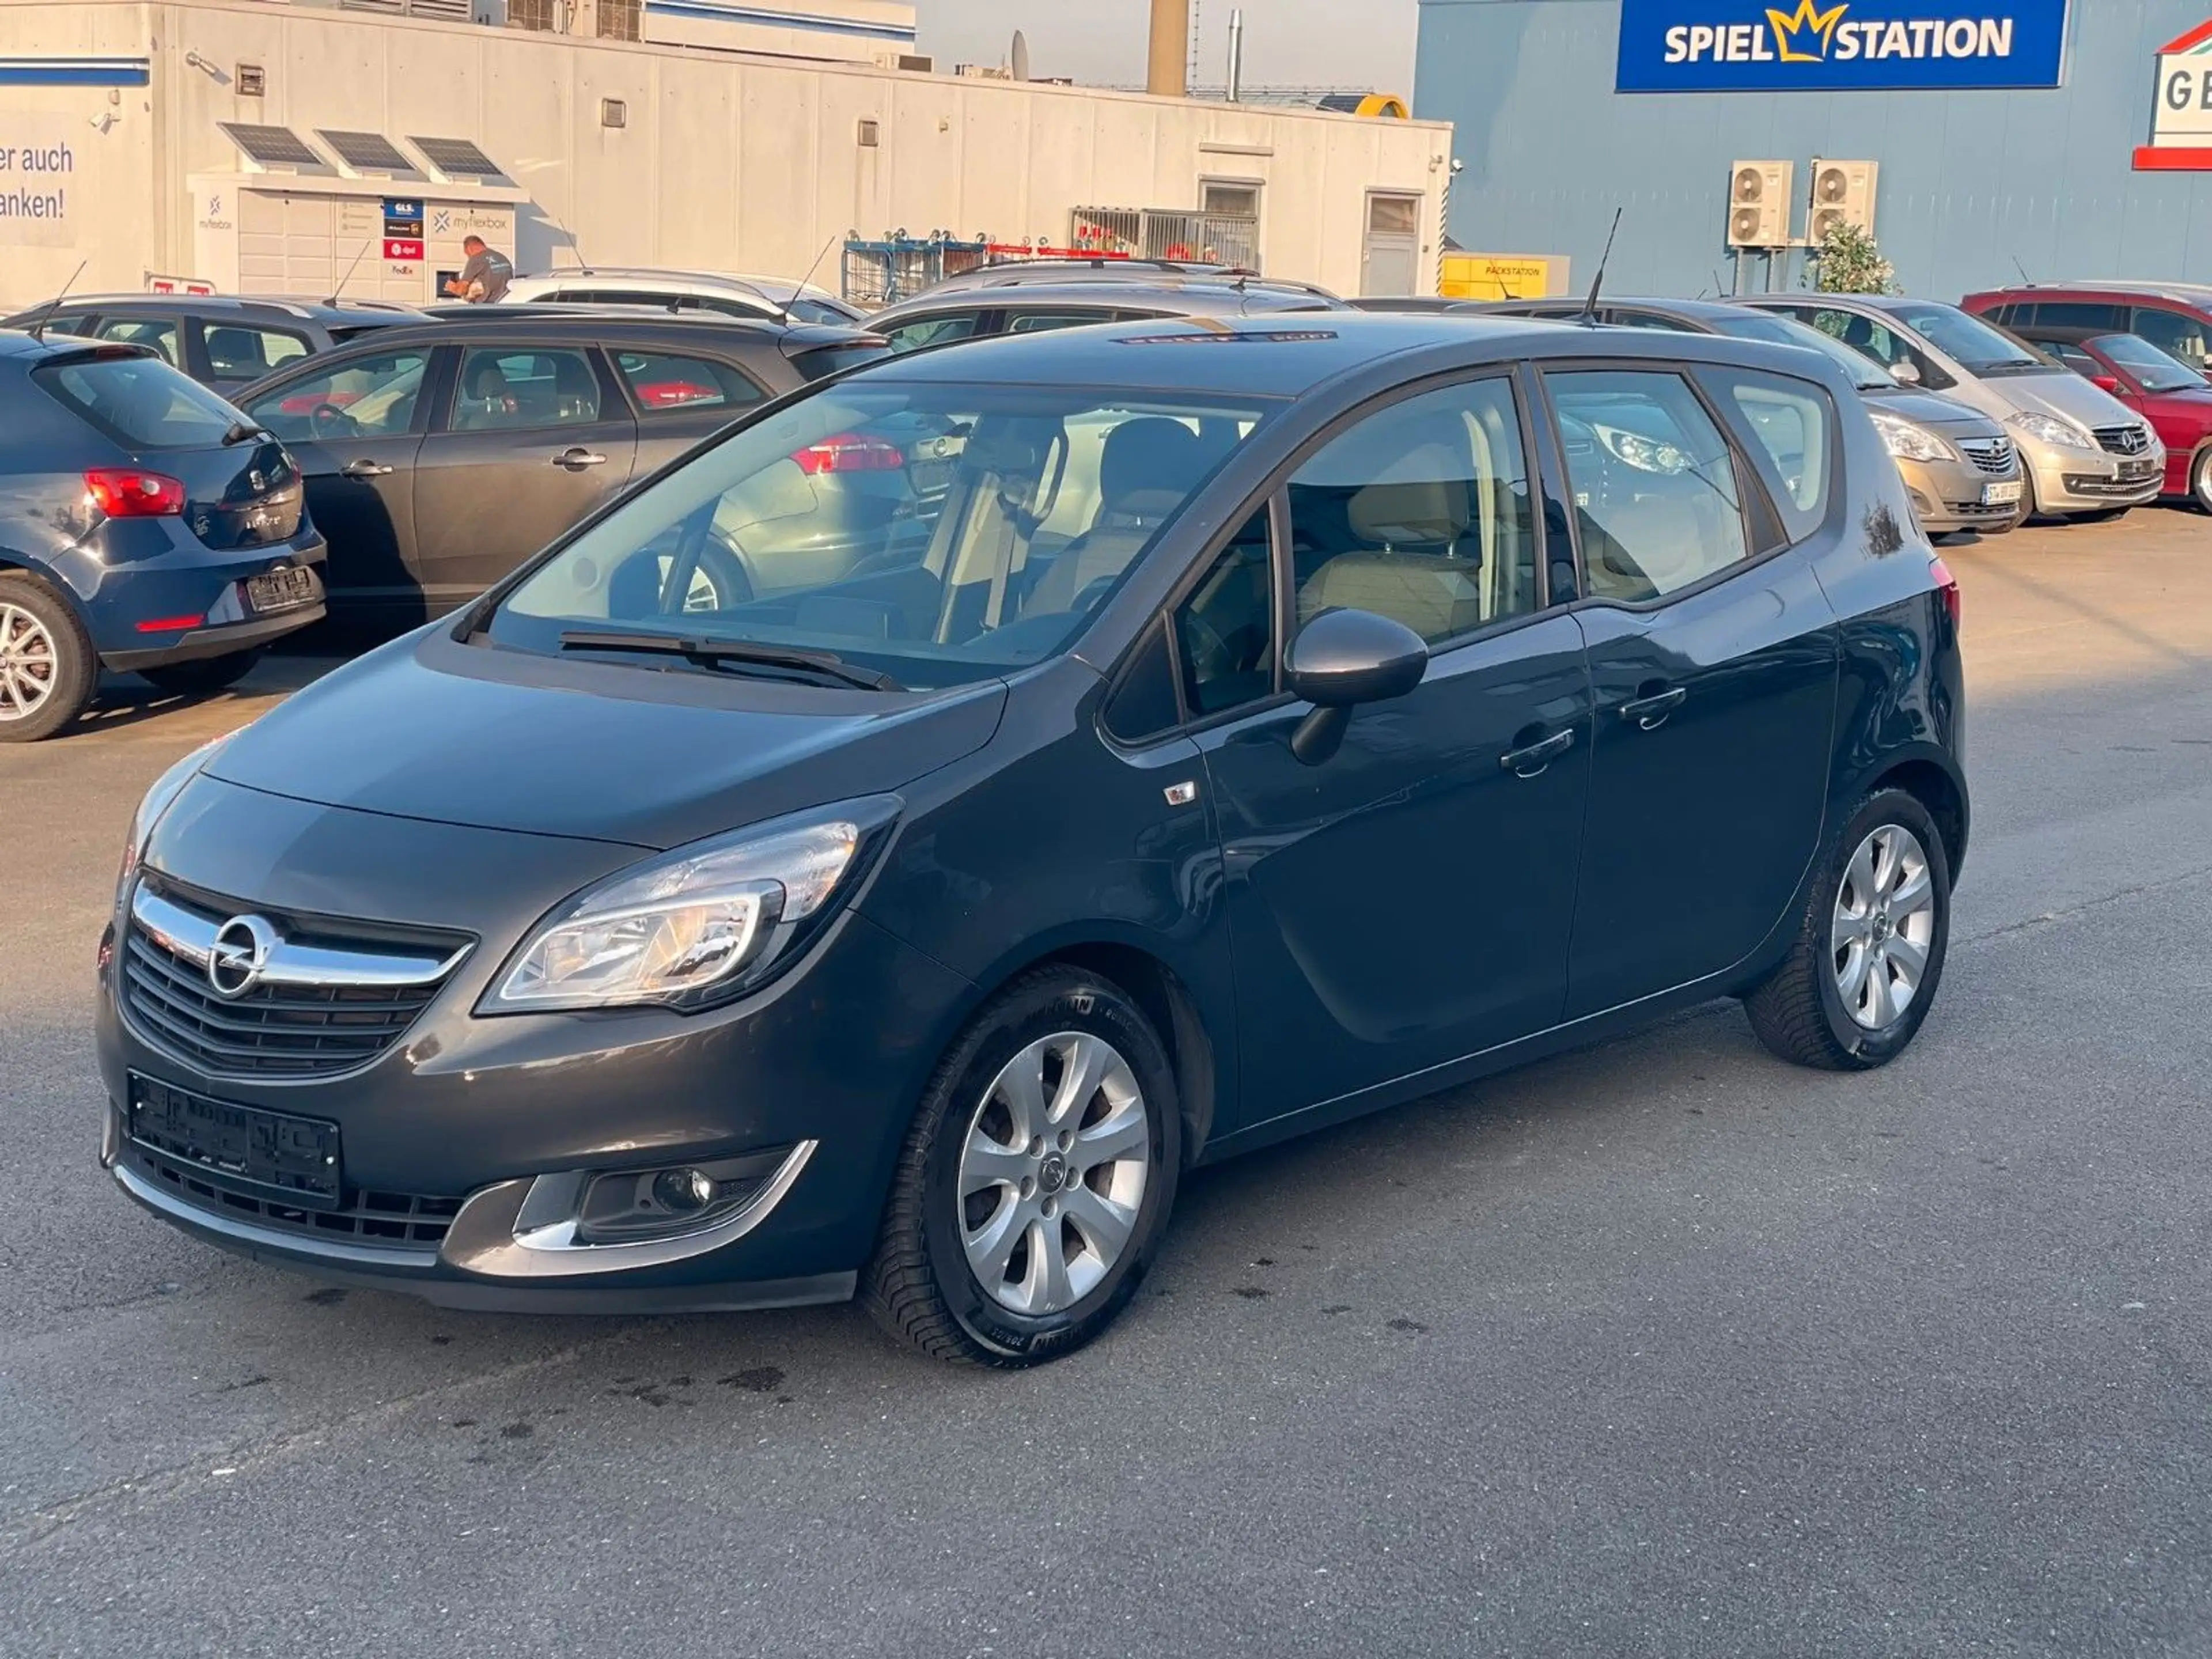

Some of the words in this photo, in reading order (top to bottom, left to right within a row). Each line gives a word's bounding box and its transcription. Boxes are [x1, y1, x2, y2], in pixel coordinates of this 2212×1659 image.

[1664, 25, 1773, 62] SPIEL
[1834, 19, 2013, 59] STATION
[22, 141, 72, 172] auch
[1486, 266, 1540, 276] PACKSTATION
